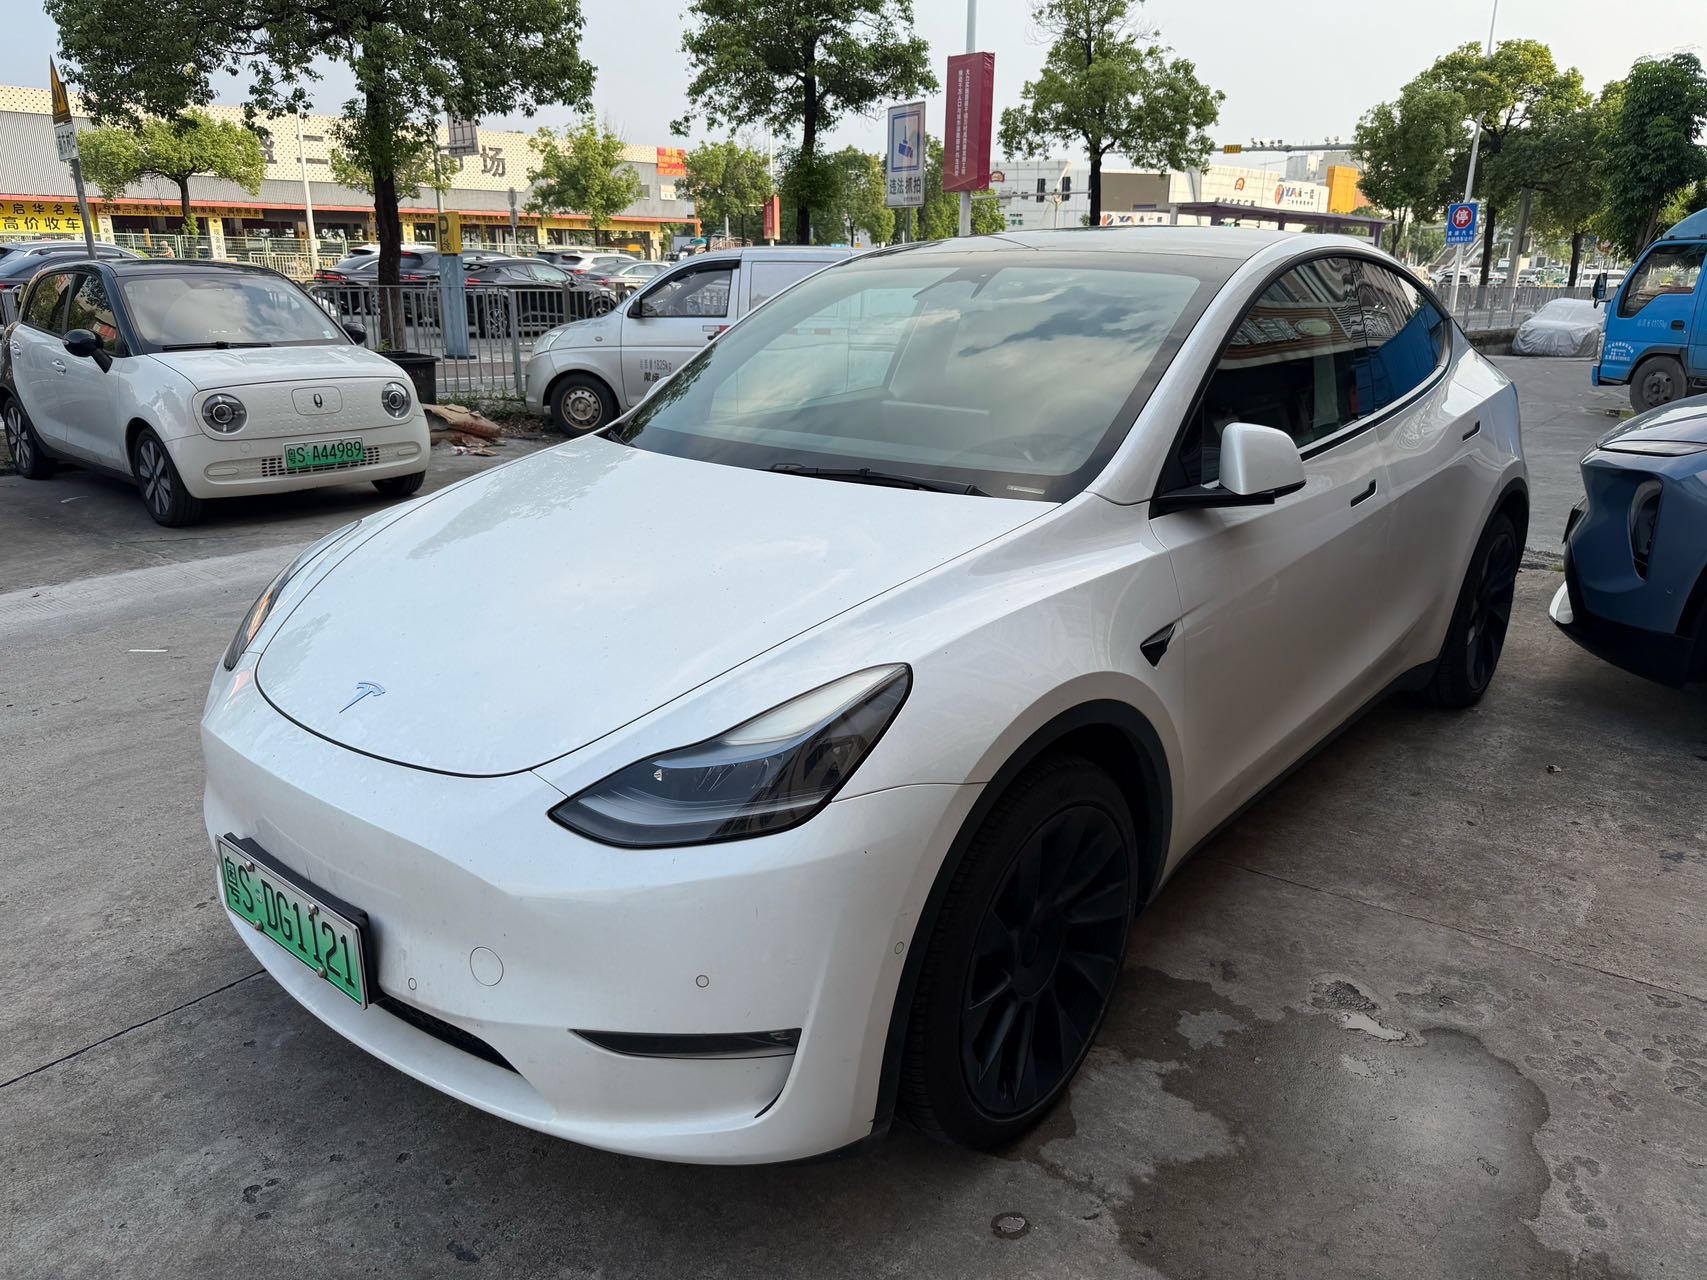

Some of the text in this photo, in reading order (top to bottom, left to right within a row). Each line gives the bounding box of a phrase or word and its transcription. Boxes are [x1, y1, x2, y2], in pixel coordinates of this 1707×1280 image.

[2, 216, 81, 231] 高价收车
[1456, 210, 1469, 224] 停
